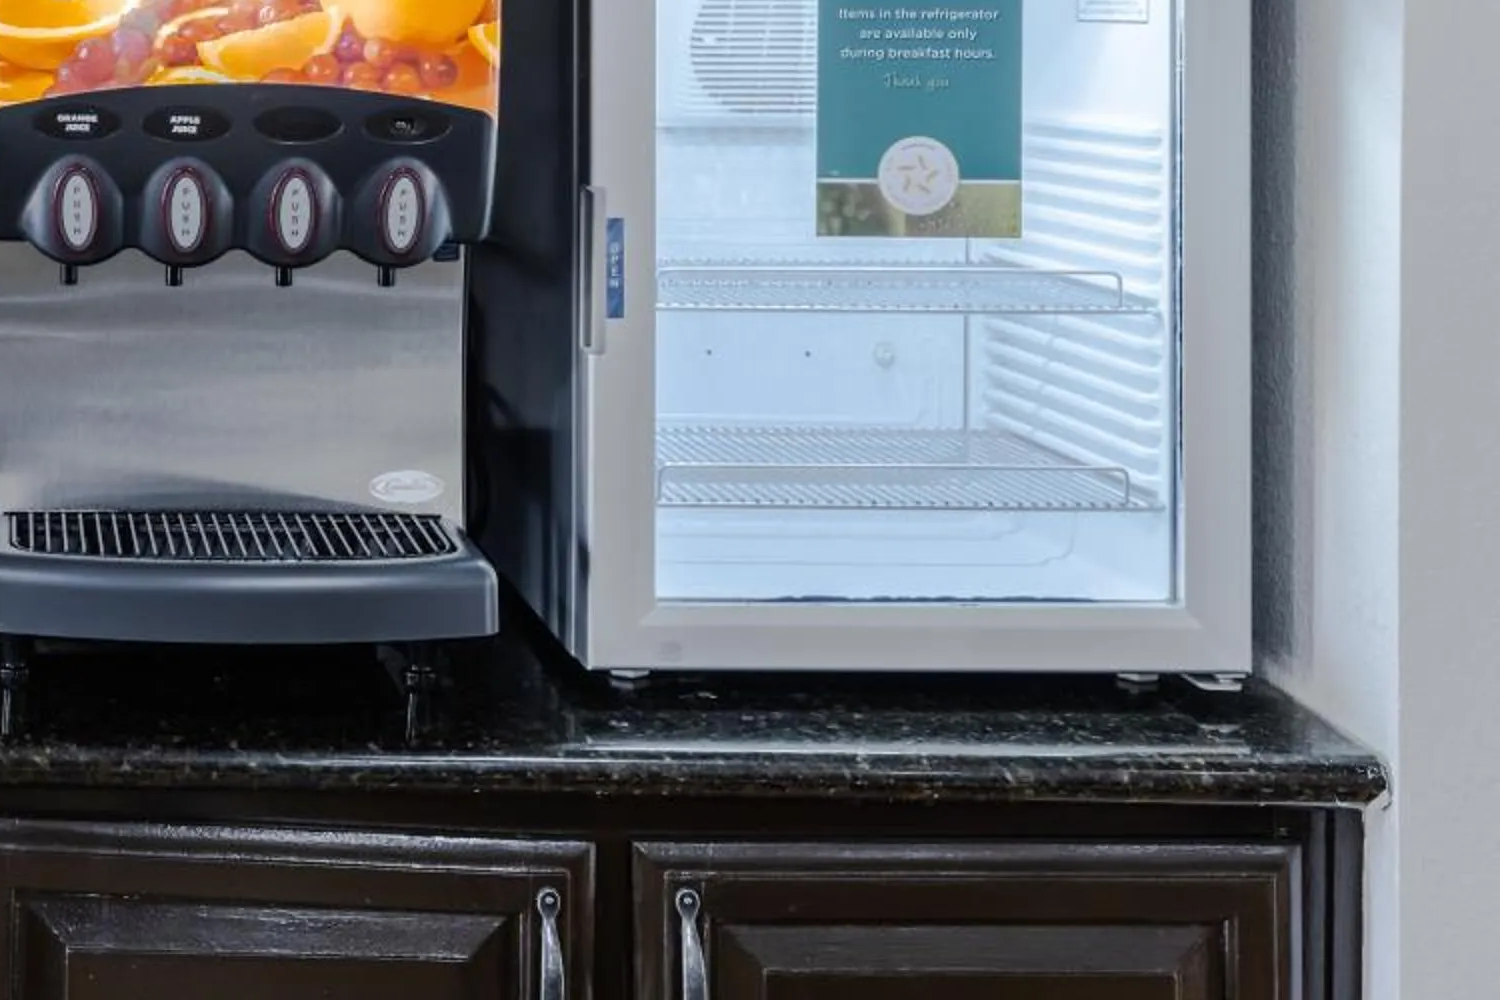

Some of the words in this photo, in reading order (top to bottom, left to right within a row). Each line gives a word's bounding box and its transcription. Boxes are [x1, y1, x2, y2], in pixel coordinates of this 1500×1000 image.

[838, 8, 876, 20] Items
[879, 8, 892, 20] in
[895, 8, 918, 20] the
[921, 8, 1000, 23] refrigerator
[859, 30, 881, 40] are
[885, 27, 944, 40] available
[947, 27, 978, 42] only
[840, 47, 885, 61] during
[888, 47, 951, 60] breakfast
[954, 47, 995, 60] hours.
[56, 114, 98, 123] ORANGE
[169, 115, 201, 125] APPLE
[65, 123, 91, 132] JUICE
[171, 125, 197, 134] JUICE
